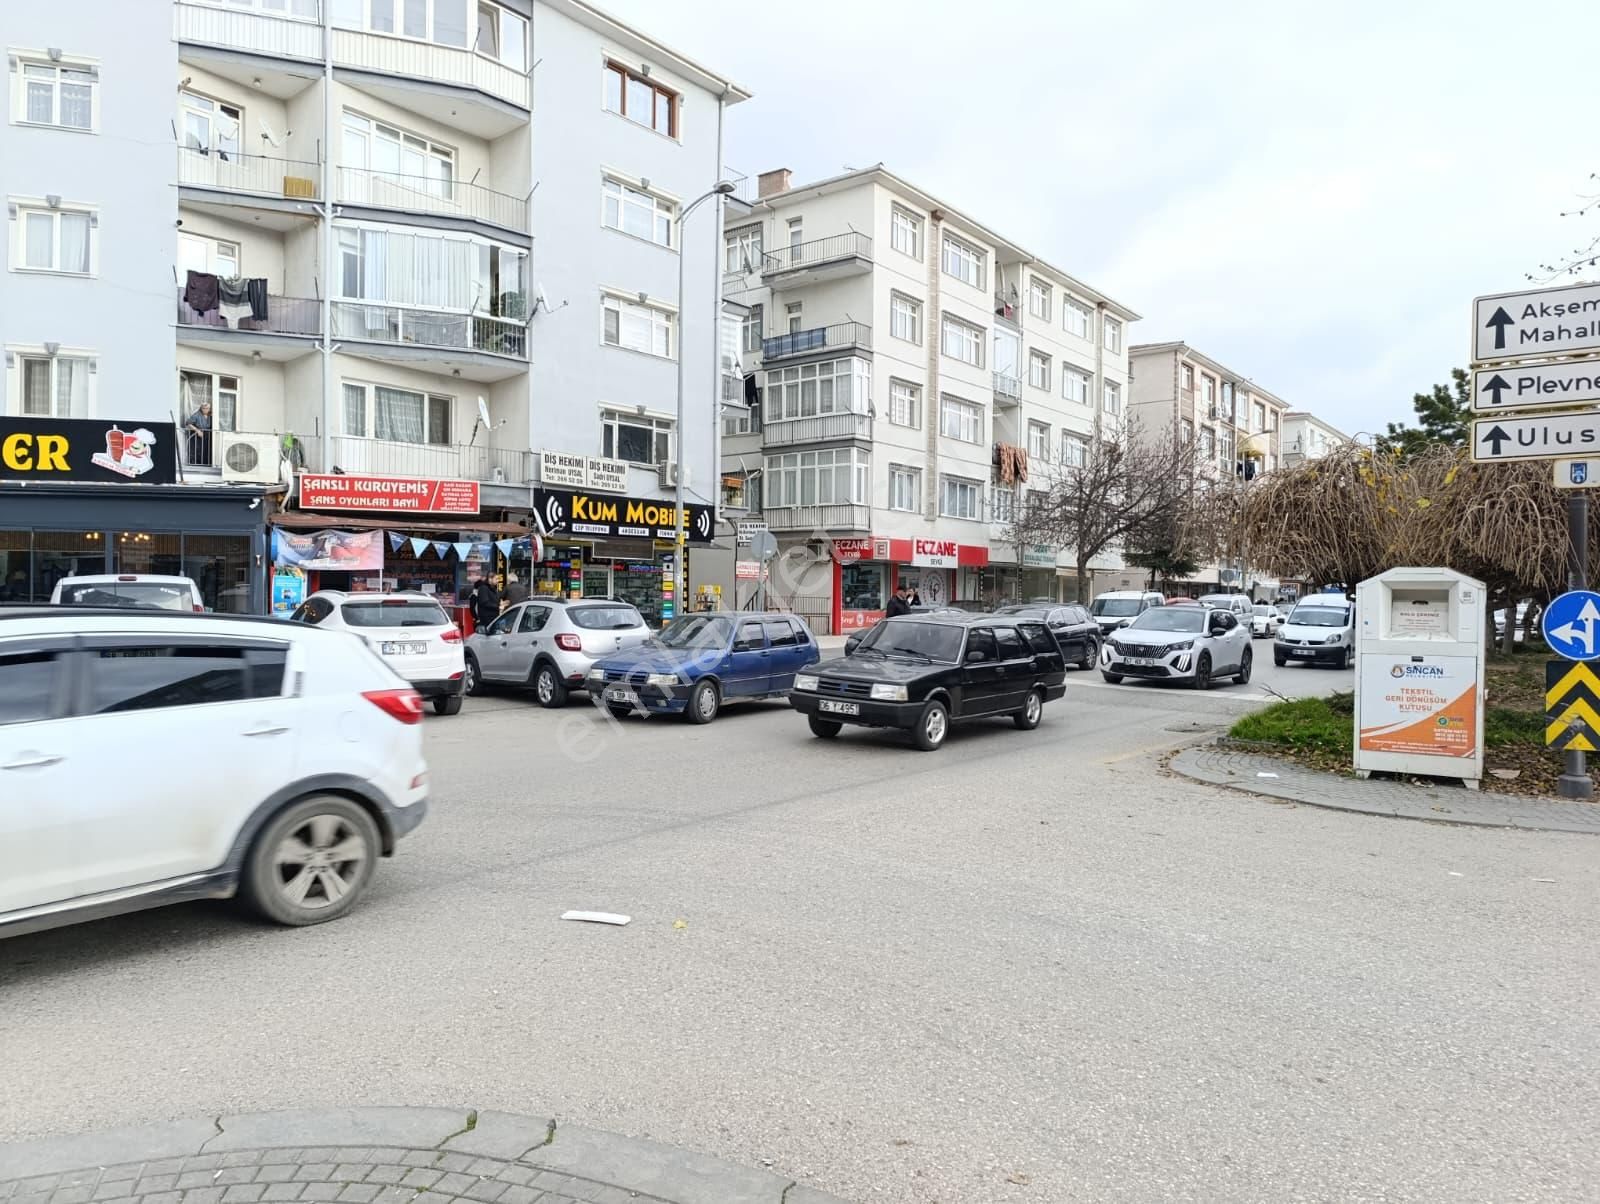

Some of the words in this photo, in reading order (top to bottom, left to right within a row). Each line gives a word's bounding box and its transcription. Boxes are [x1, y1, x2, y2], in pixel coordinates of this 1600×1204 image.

[1517, 427, 1595, 447] Ulus
[559, 456, 584, 469] HEKİMİ
[304, 478, 349, 492] ŞANSLI
[354, 480, 428, 496] KURUYEMİŞ
[310, 495, 336, 506] ŞANS
[339, 496, 390, 506] OYUNLARI
[572, 496, 617, 522] KUM
[835, 540, 869, 550] ECZANE
[916, 539, 957, 557] ECZANE
[1406, 665, 1444, 675] SİNCAN
[1400, 687, 1434, 695] TEKSTİL
[1406, 695, 1448, 704] DÖNÜŞÜM
[1399, 703, 1433, 711] KUTUSU
